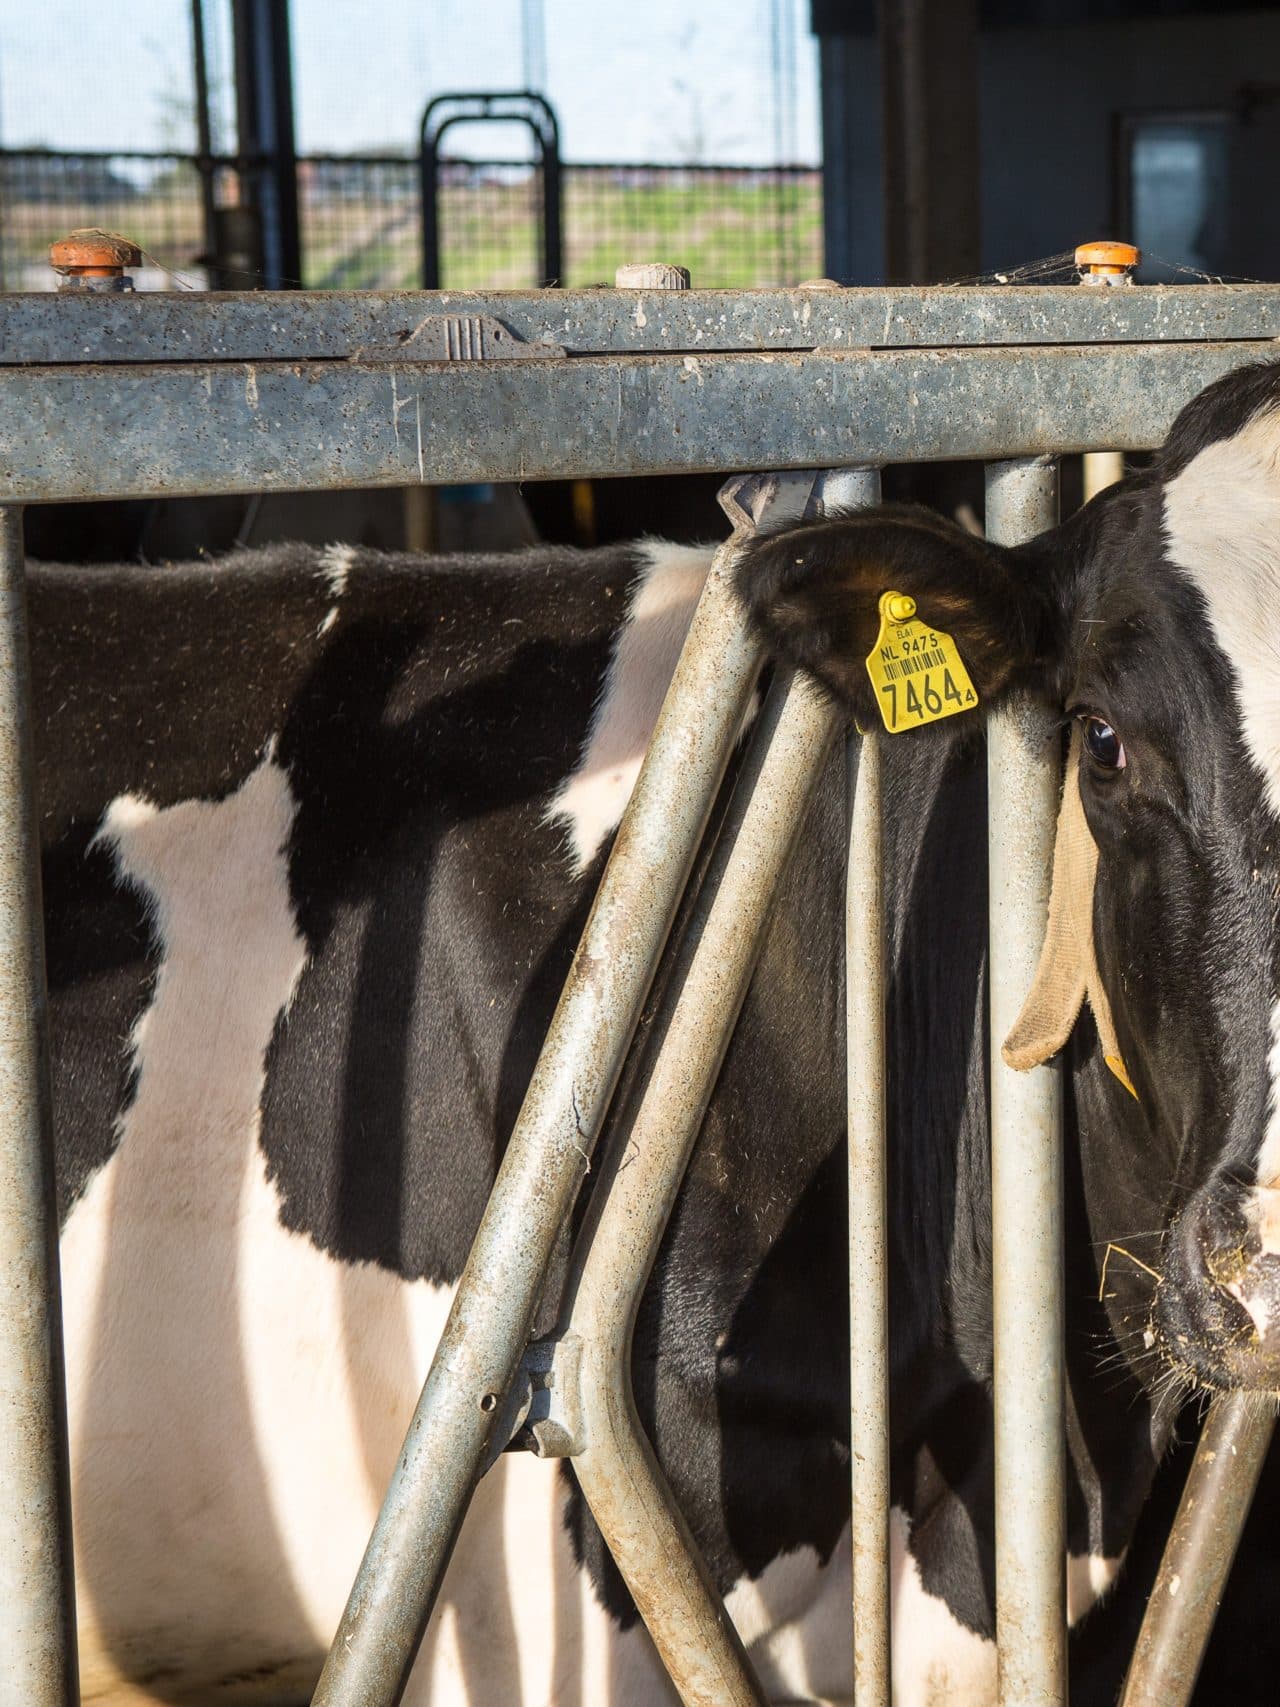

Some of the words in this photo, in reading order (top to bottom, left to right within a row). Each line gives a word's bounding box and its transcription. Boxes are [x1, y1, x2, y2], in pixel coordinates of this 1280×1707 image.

[880, 645, 899, 662] NL
[902, 633, 938, 656] 9475
[881, 667, 963, 728] 7464
[965, 688, 975, 703] 4
